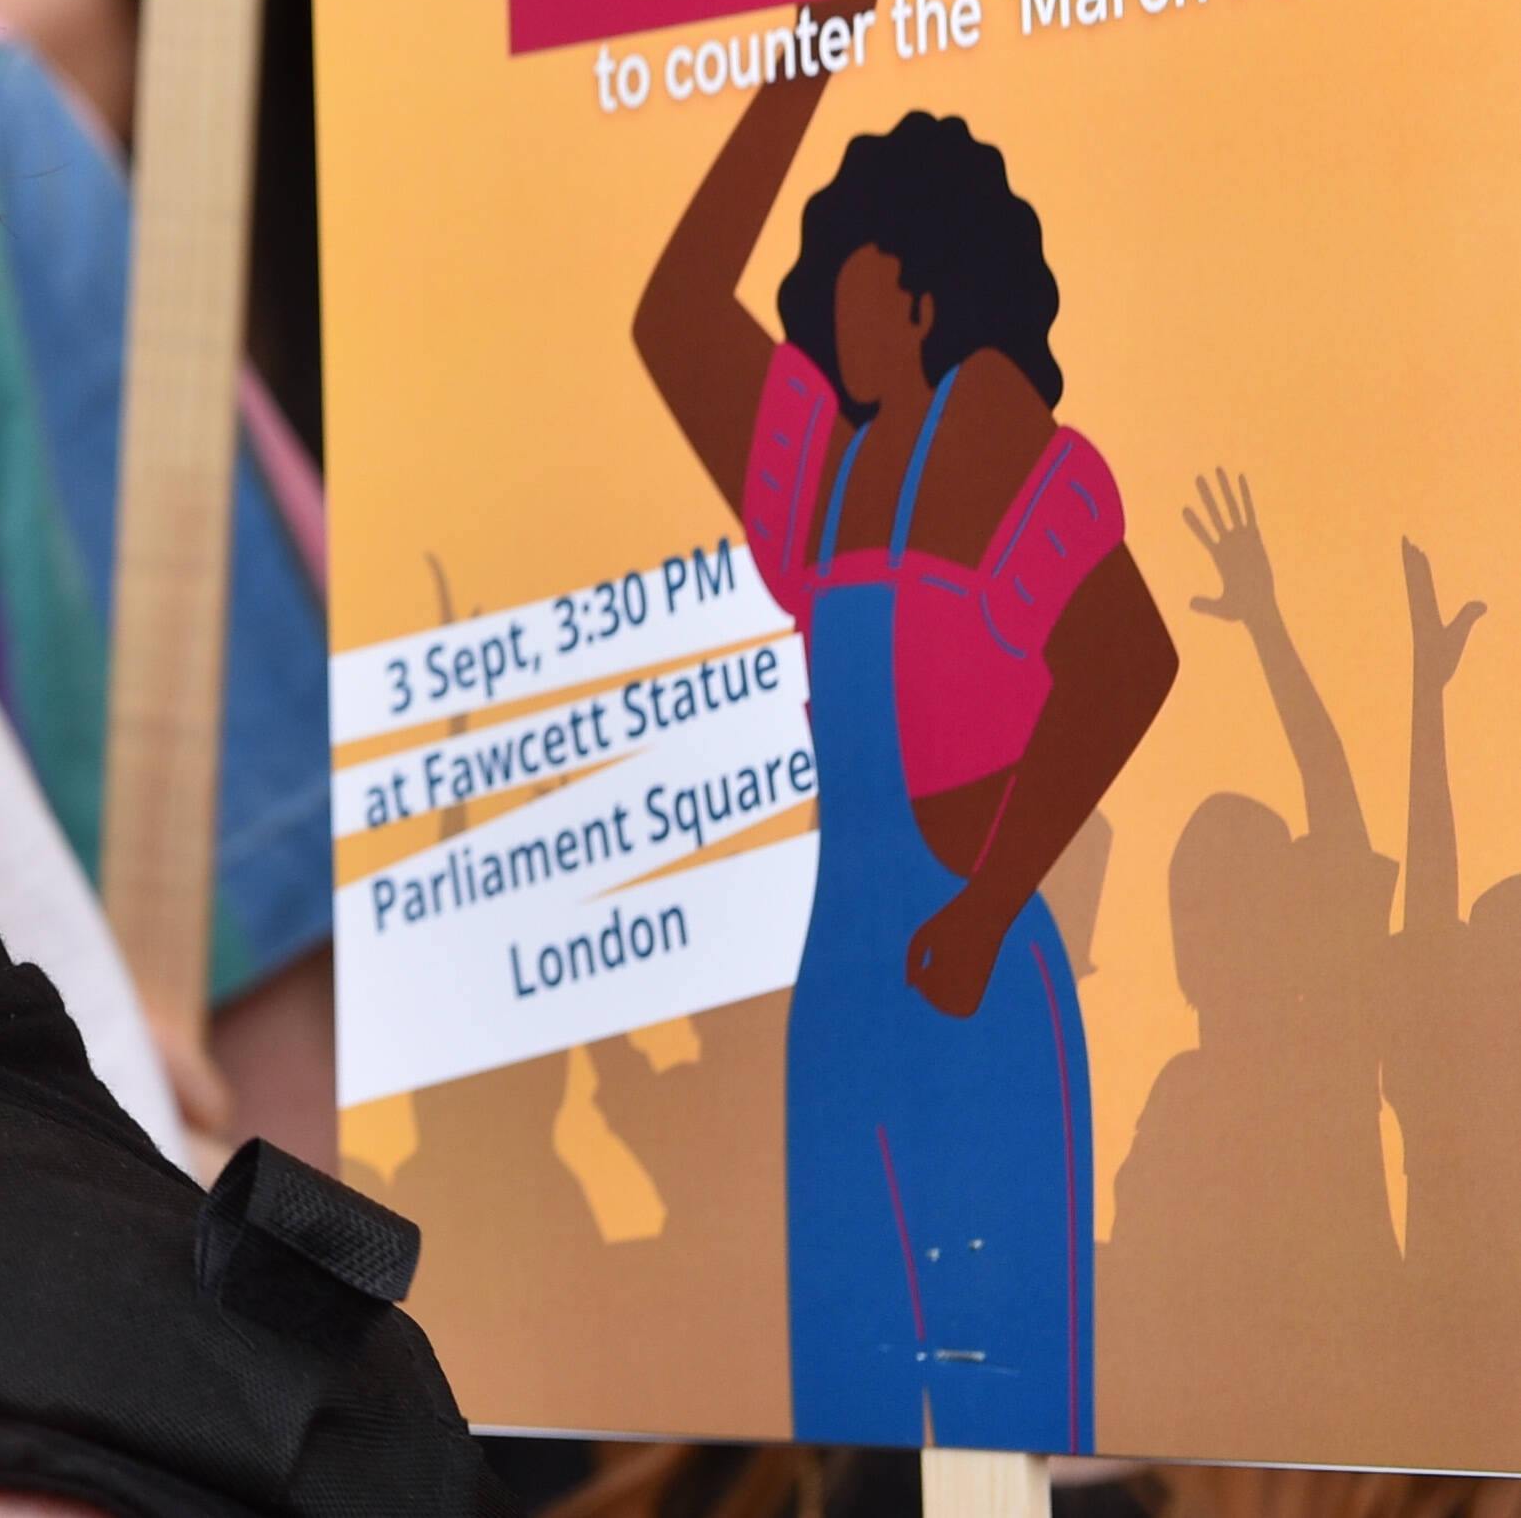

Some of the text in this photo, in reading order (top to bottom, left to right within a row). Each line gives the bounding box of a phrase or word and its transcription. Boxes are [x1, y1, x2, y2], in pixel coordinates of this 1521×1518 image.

[593, 42, 651, 114] to
[663, 5, 877, 104] counter
[385, 537, 737, 714] 3 Sept, 3:30 PM
[365, 646, 780, 830] at Fawcett Statue
[371, 746, 814, 934] Parliament Square
[509, 902, 690, 1000] London
